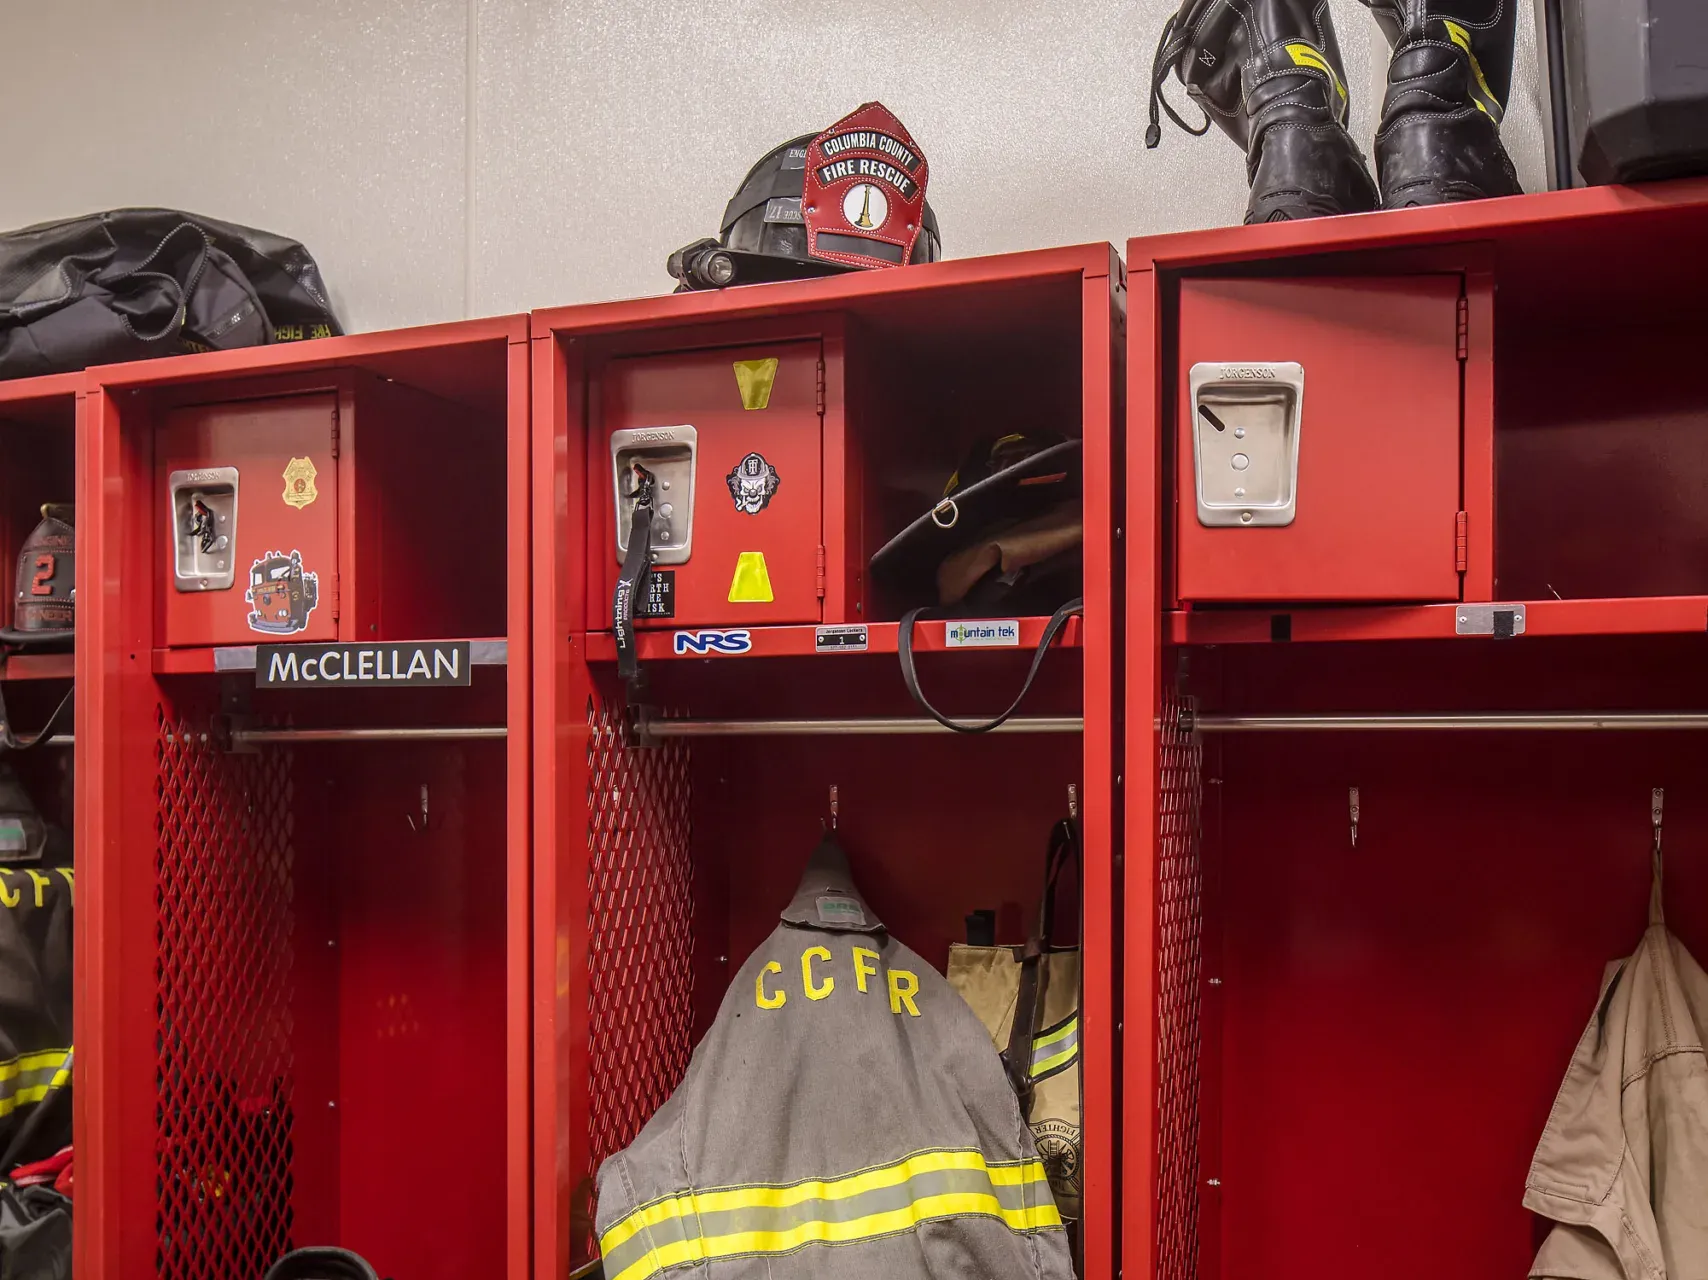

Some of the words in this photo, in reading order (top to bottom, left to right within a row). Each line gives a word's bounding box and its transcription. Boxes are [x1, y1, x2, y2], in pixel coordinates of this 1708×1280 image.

[789, 149, 807, 158] ENGI
[824, 132, 876, 156] COLUMBIA
[879, 136, 914, 166] COUNTY
[823, 160, 855, 182] FIRE
[860, 159, 911, 193] RESCUE
[783, 210, 801, 221] SCUE
[274, 324, 303, 340] FIGH
[1219, 367, 1276, 380] JORGENSON
[631, 431, 675, 443] JORGENSON
[31, 554, 55, 595] 2
[650, 583, 669, 593] RTH
[649, 594, 661, 602] HE
[647, 603, 665, 613] ISK
[615, 589, 626, 649] Lightning
[998, 626, 1015, 637] tek
[675, 632, 750, 652] NRS
[839, 636, 845, 645] 1
[268, 648, 459, 682] McCLELLAN
[756, 945, 922, 1017] CCFR
[1034, 1124, 1076, 1136] FIGHTER
